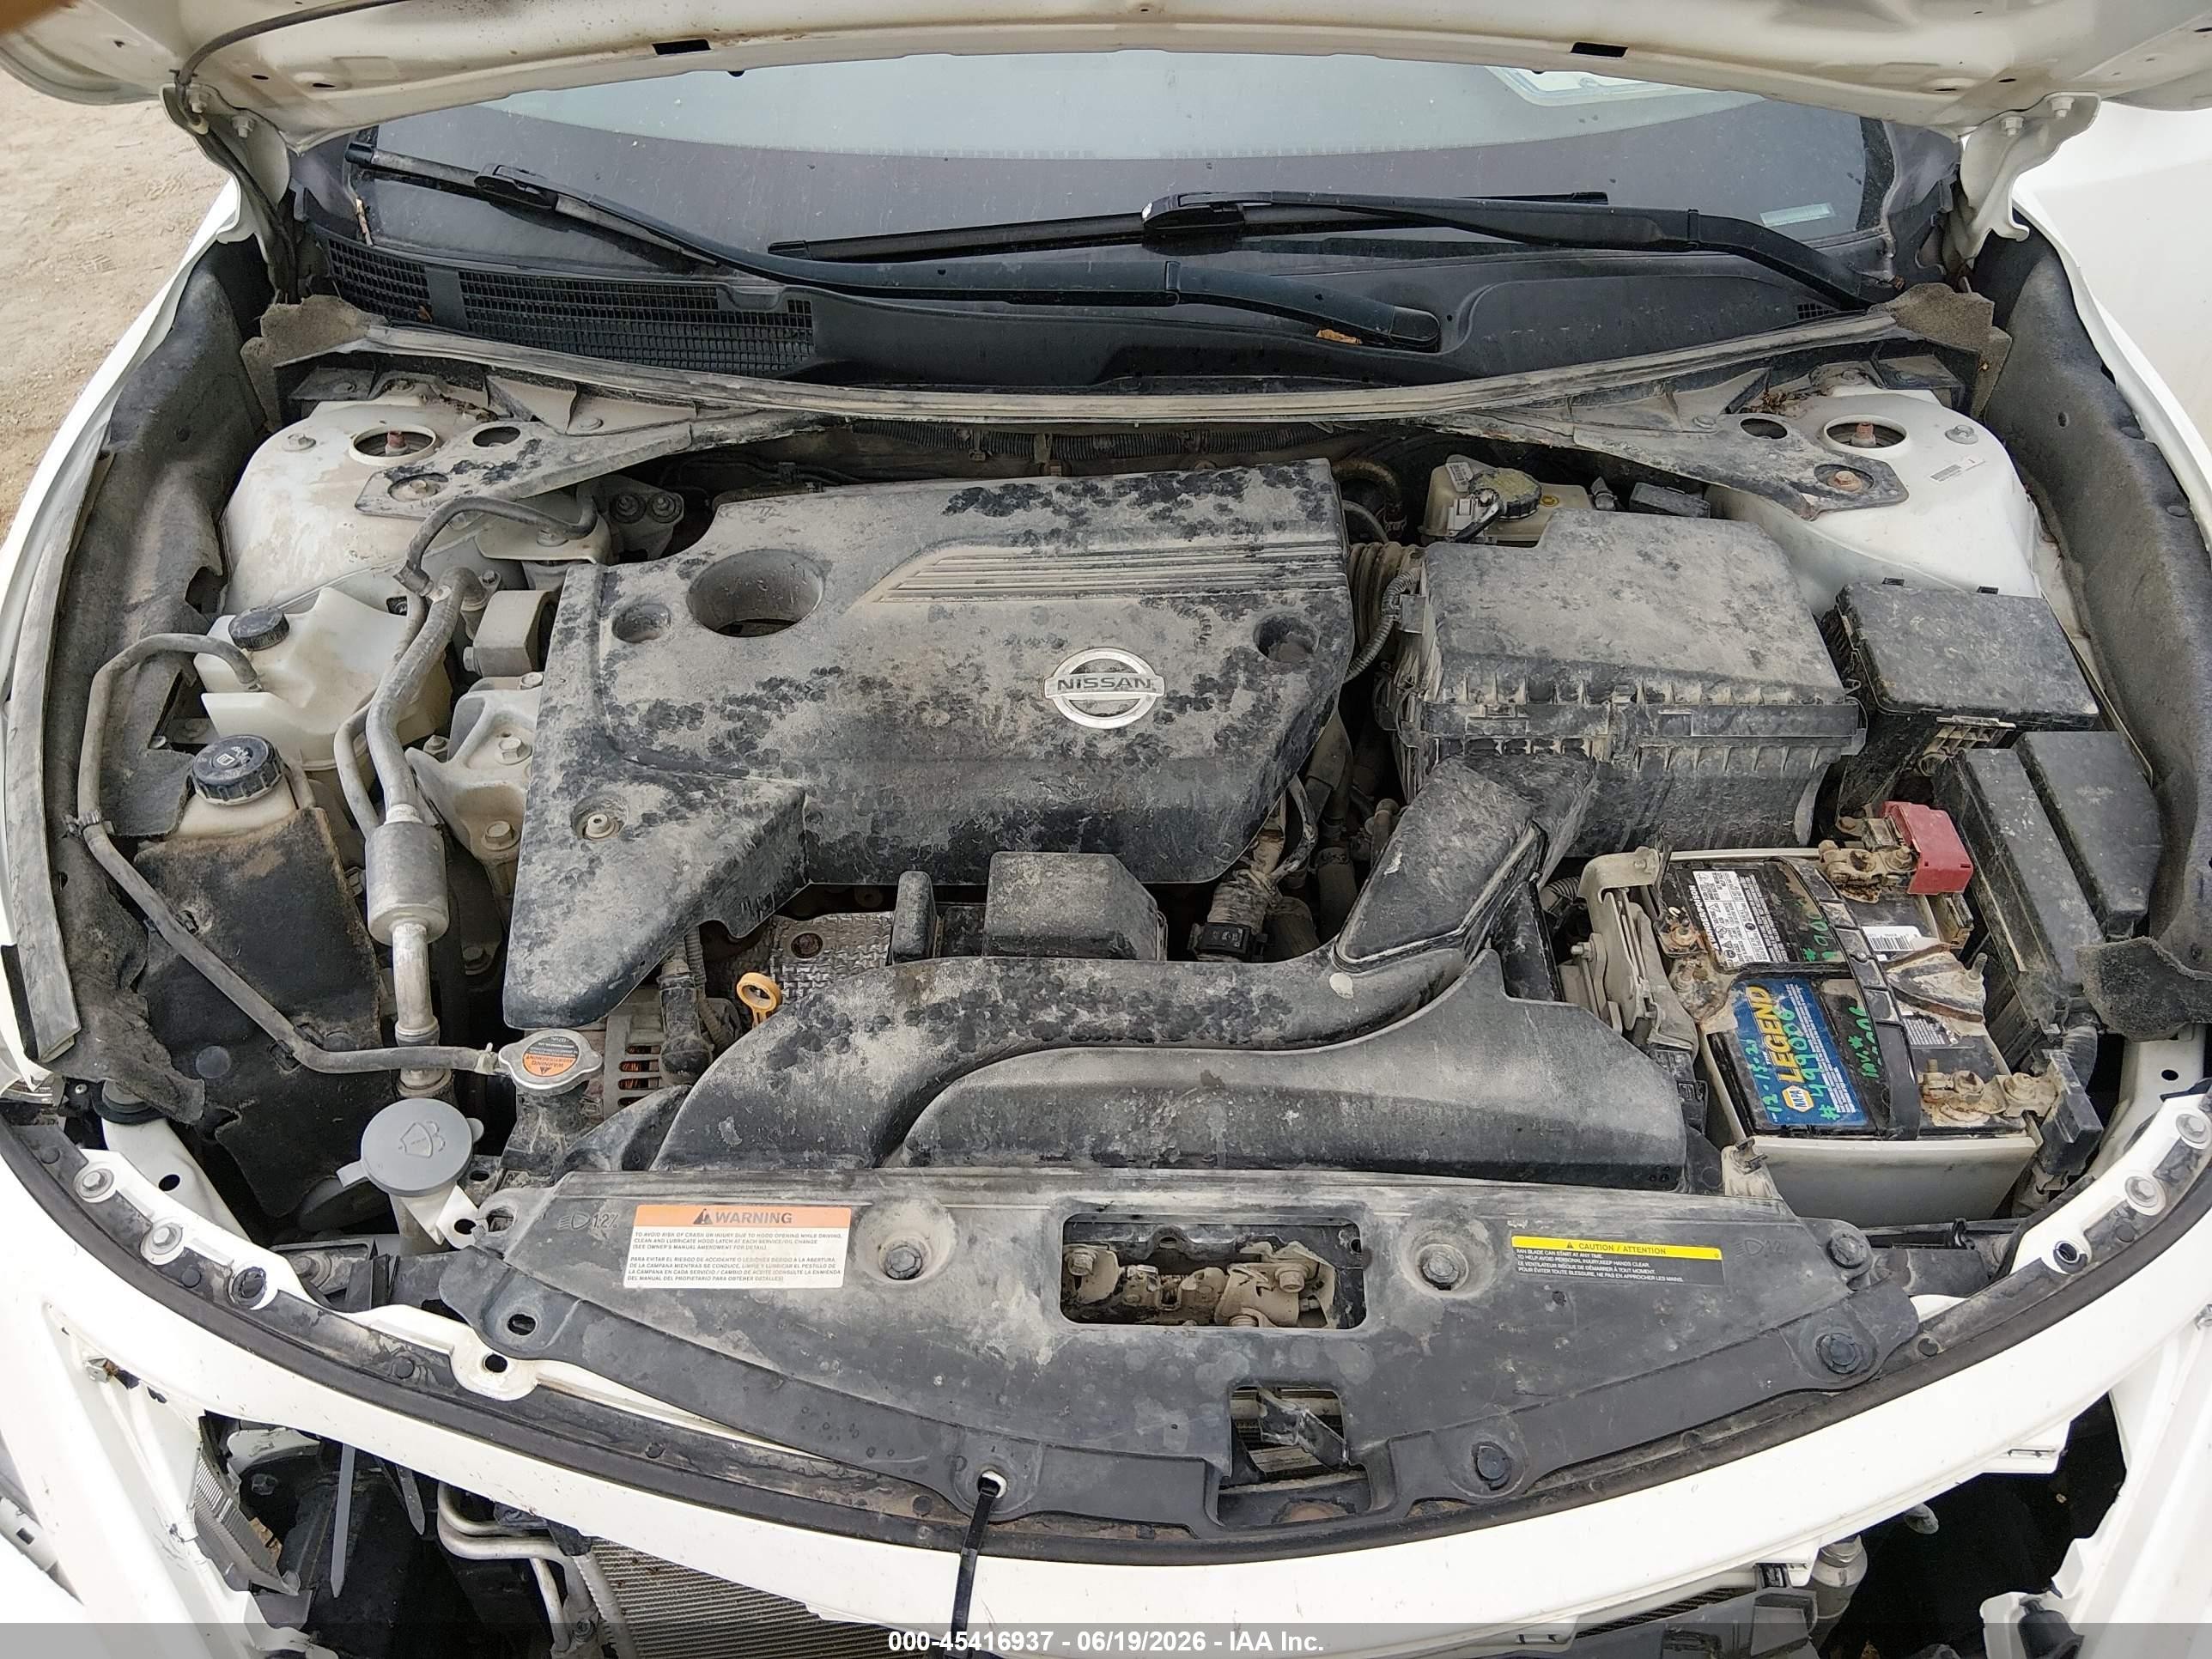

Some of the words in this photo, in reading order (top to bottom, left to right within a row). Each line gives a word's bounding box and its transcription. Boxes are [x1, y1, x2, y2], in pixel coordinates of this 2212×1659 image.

[1057, 678, 1151, 690] NISSAN
[1746, 986, 1805, 1083] LEGEND
[1761, 1050, 1773, 1065] THE
[1789, 1089, 1807, 1108] NAPA
[715, 1212, 793, 1224] WARNING
